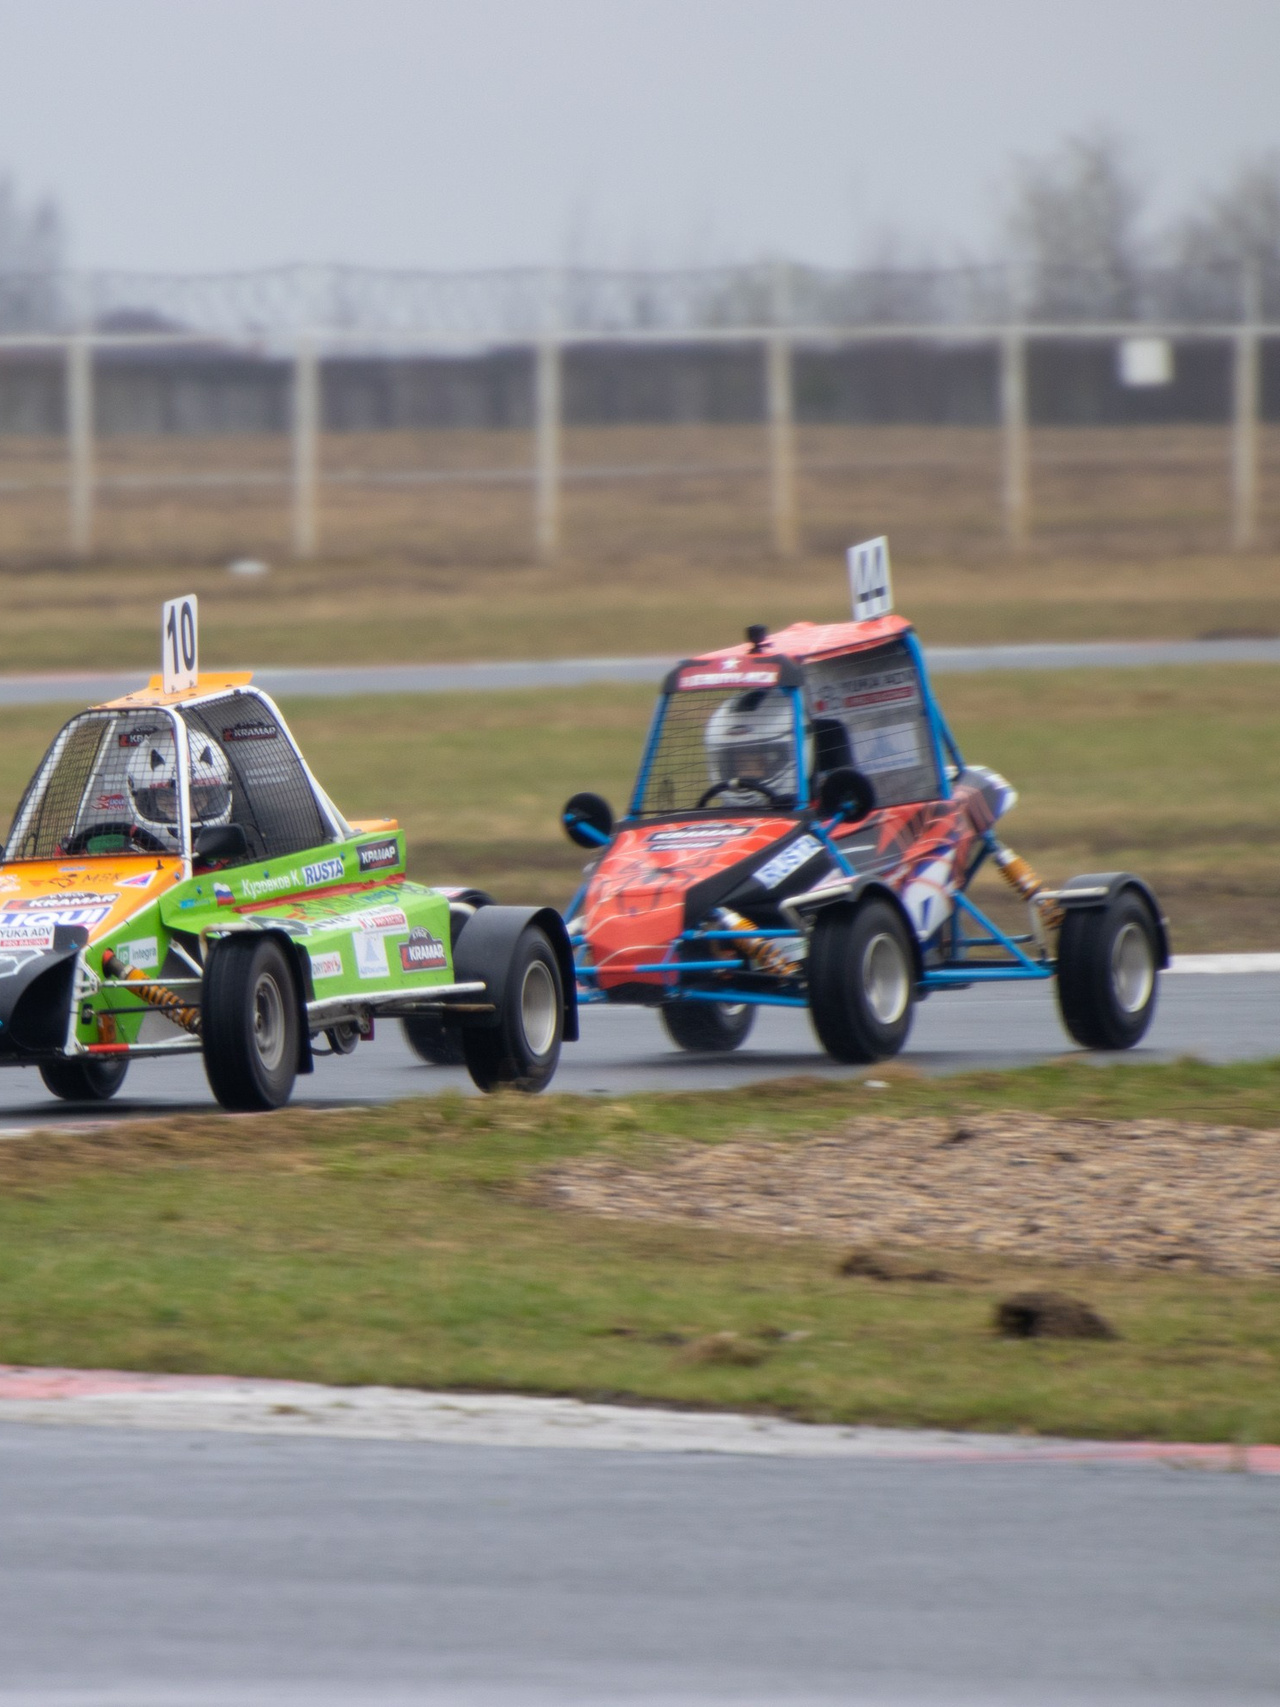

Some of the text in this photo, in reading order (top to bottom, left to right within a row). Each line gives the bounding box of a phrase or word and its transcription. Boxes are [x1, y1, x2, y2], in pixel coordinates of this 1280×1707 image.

[167, 601, 195, 674] 10
[305, 859, 344, 886] RUSTA
[29, 894, 117, 908] KRAMAR
[0, 926, 53, 938] YUKA ADV
[132, 946, 157, 962] integra
[408, 943, 445, 961] KRAMAR
